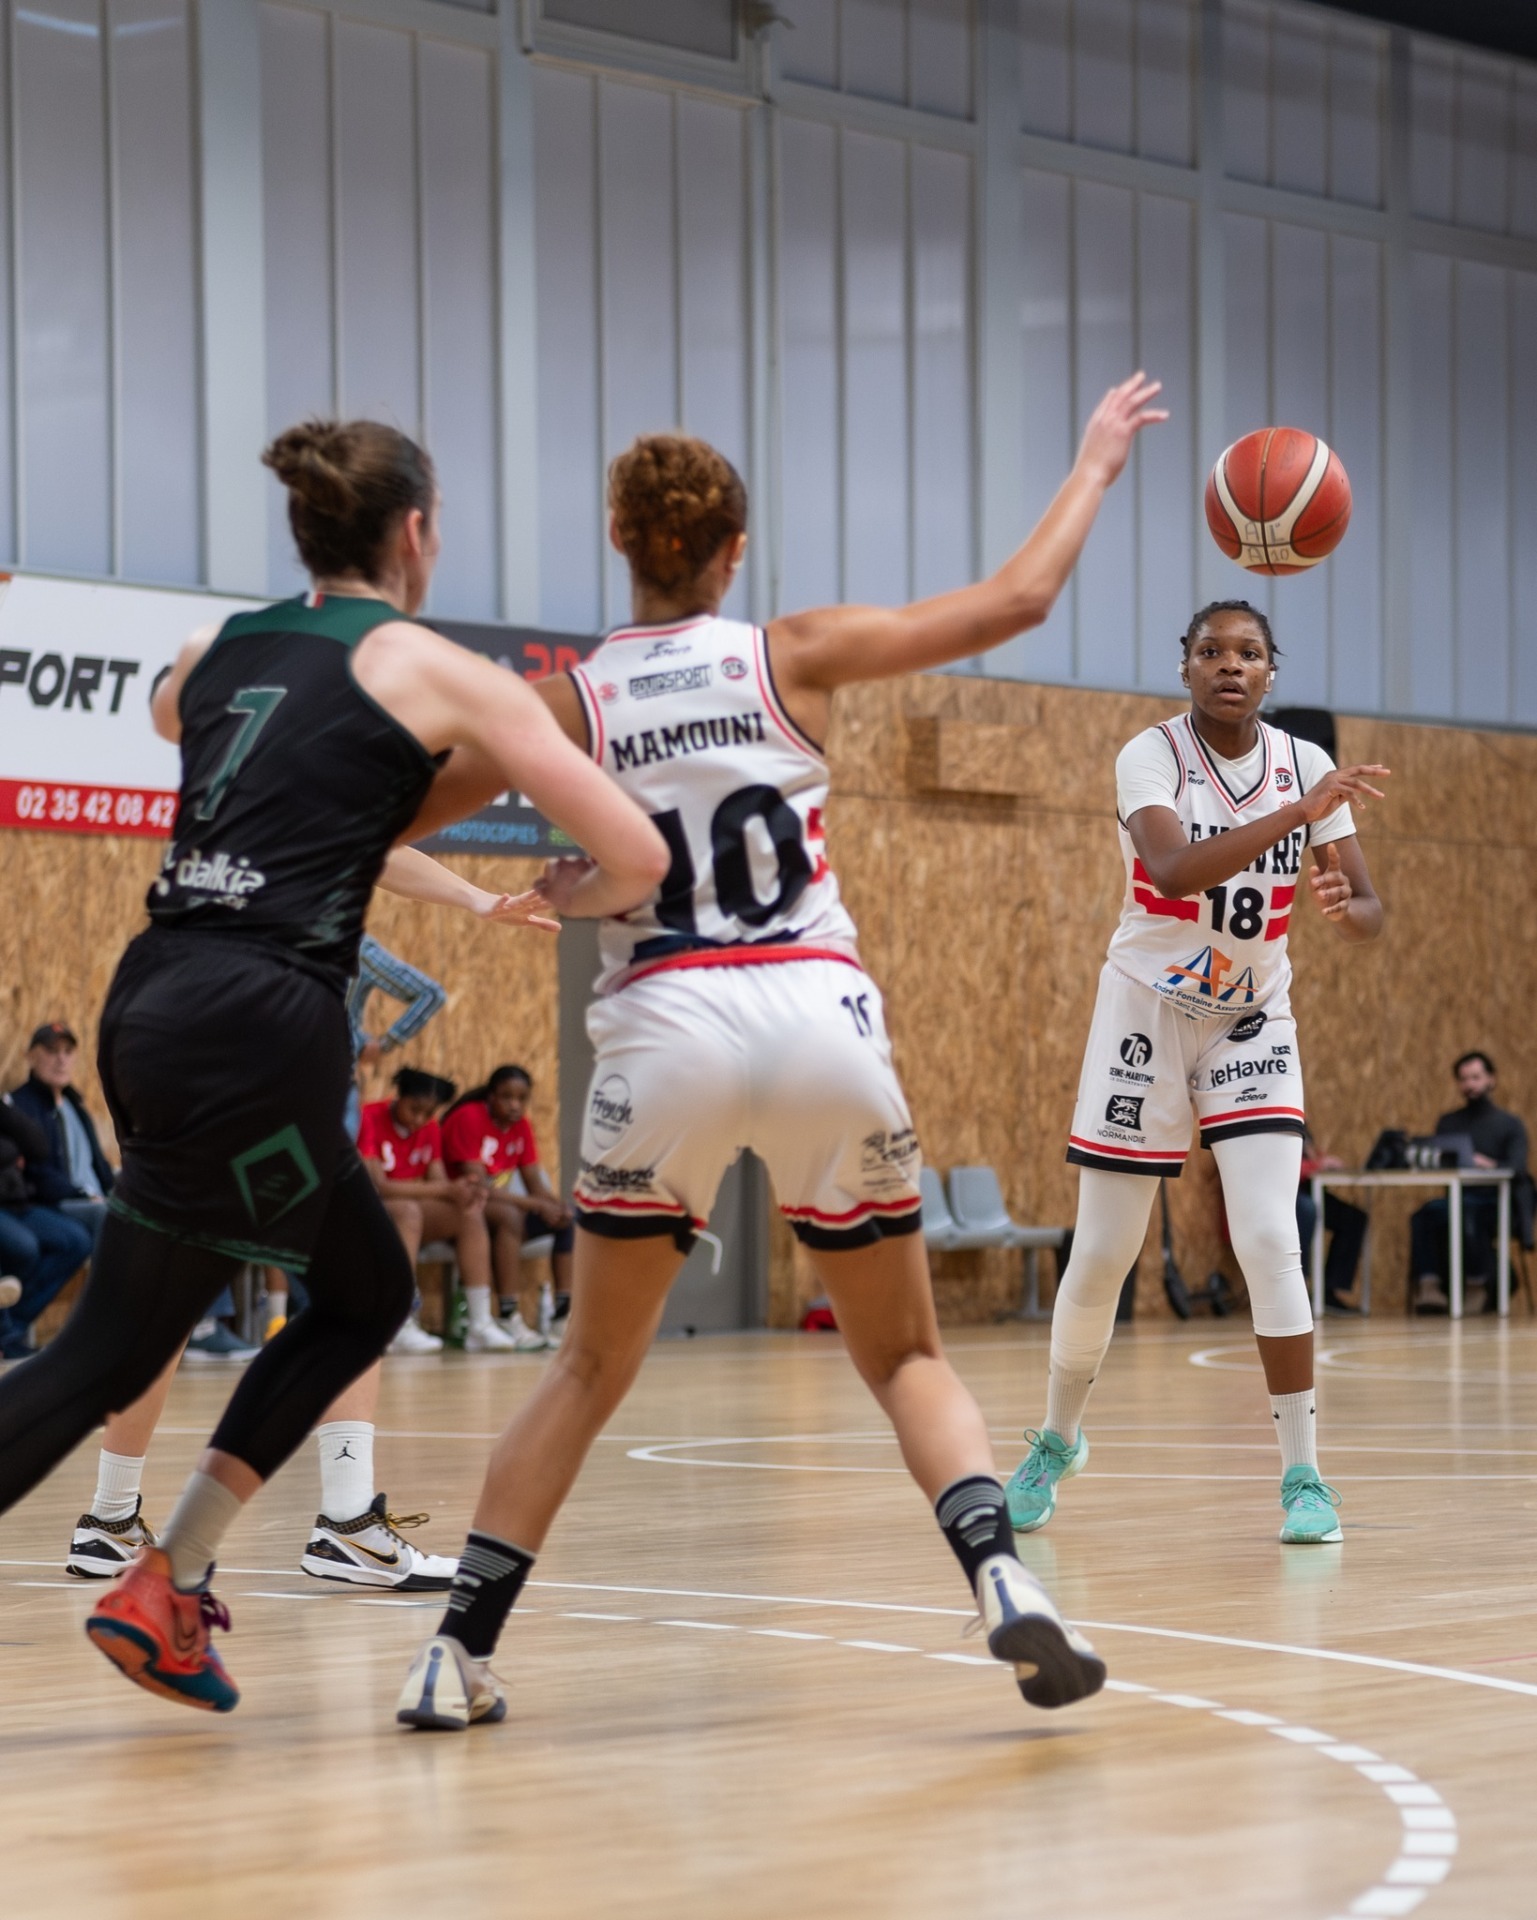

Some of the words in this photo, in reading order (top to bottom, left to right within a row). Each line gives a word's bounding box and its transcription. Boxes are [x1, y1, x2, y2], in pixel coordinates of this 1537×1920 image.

[195, 686, 288, 820] 7
[610, 712, 766, 772] MAMOUNI
[16, 785, 47, 819] 02
[50, 788, 80, 821] 35
[82, 791, 113, 824] 42
[115, 793, 144, 827] 08
[147, 796, 176, 829] 42
[650, 784, 813, 932] 10
[1208, 825, 1302, 875] VRE
[1204, 885, 1264, 941] 18
[1152, 982, 1174, 996] André
[1176, 990, 1213, 1008] Fontaine
[1123, 1035, 1148, 1067] 76
[1097, 1129, 1146, 1144] NORMANDIE
